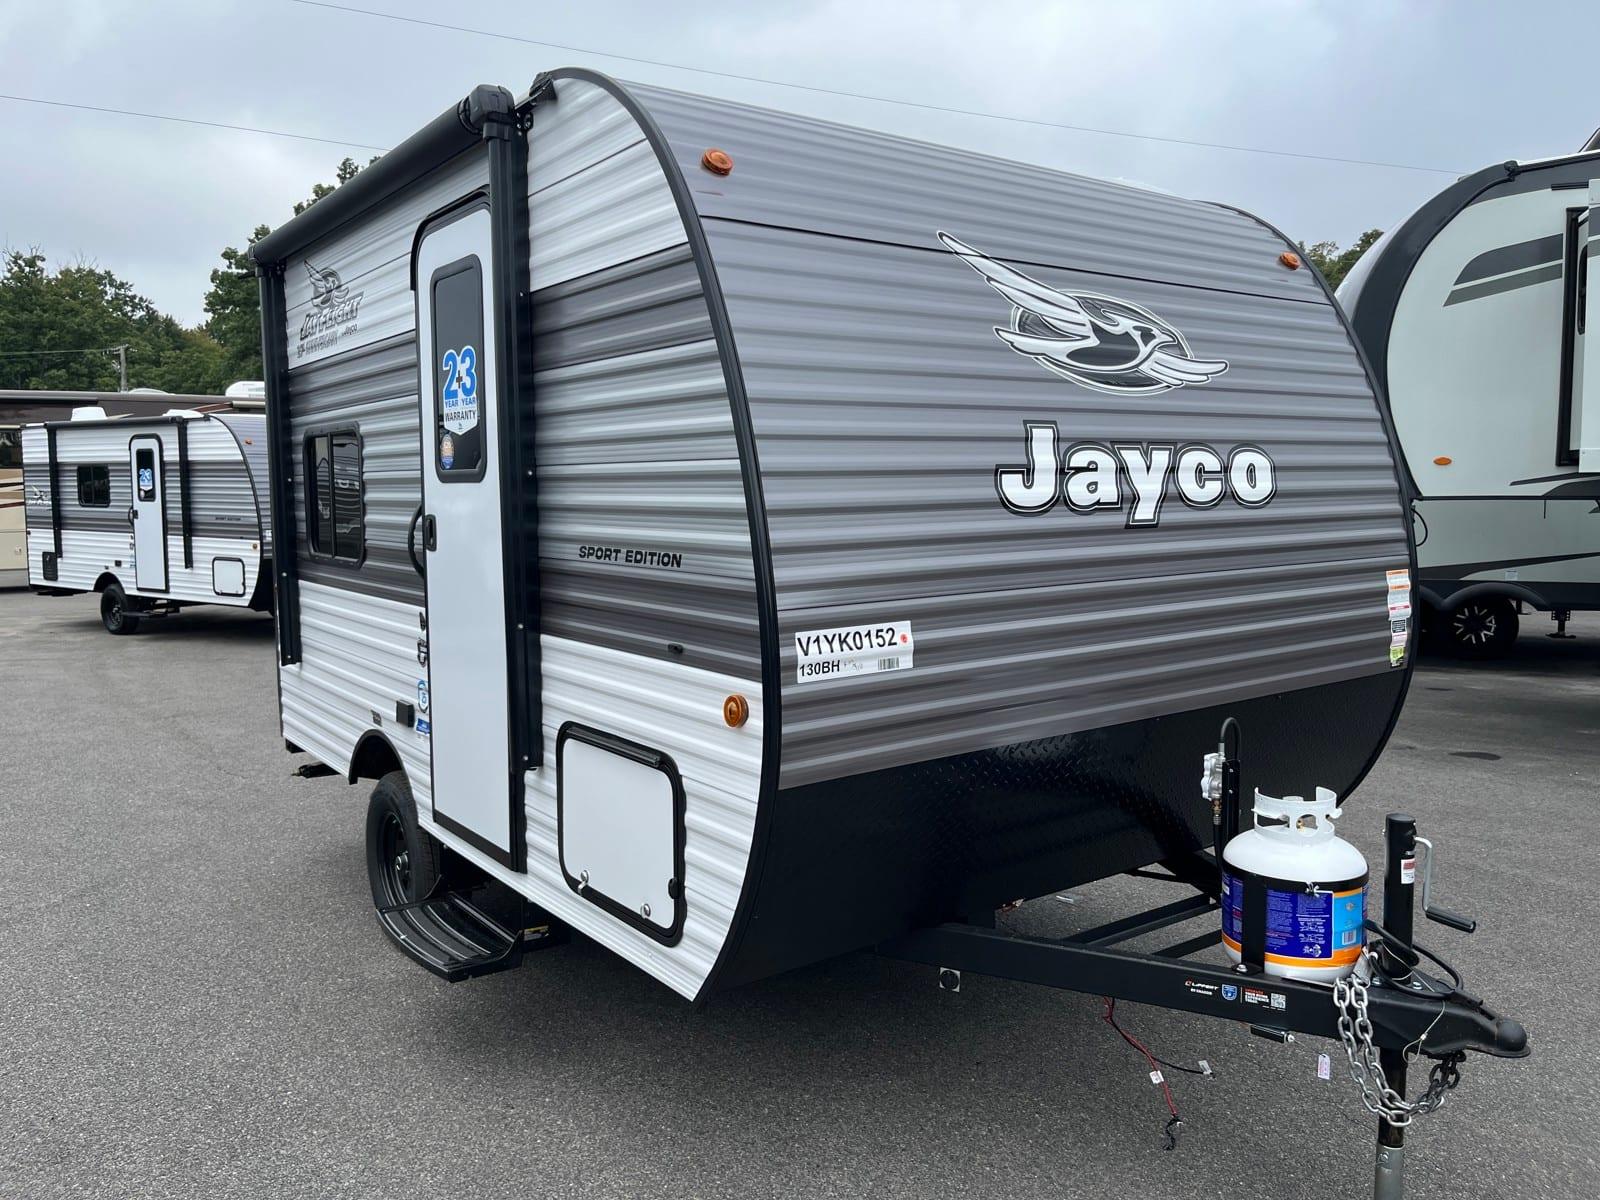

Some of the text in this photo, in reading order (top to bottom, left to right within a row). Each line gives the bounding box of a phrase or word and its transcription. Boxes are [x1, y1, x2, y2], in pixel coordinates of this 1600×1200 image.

[445, 396, 476, 409] YEAR YEAR
[445, 409, 477, 422] WARRANTY
[994, 420, 1277, 529] Jayco
[579, 545, 682, 568] SPORT EDITION
[797, 627, 897, 657] V1YK0152
[799, 660, 840, 677] 130BH
